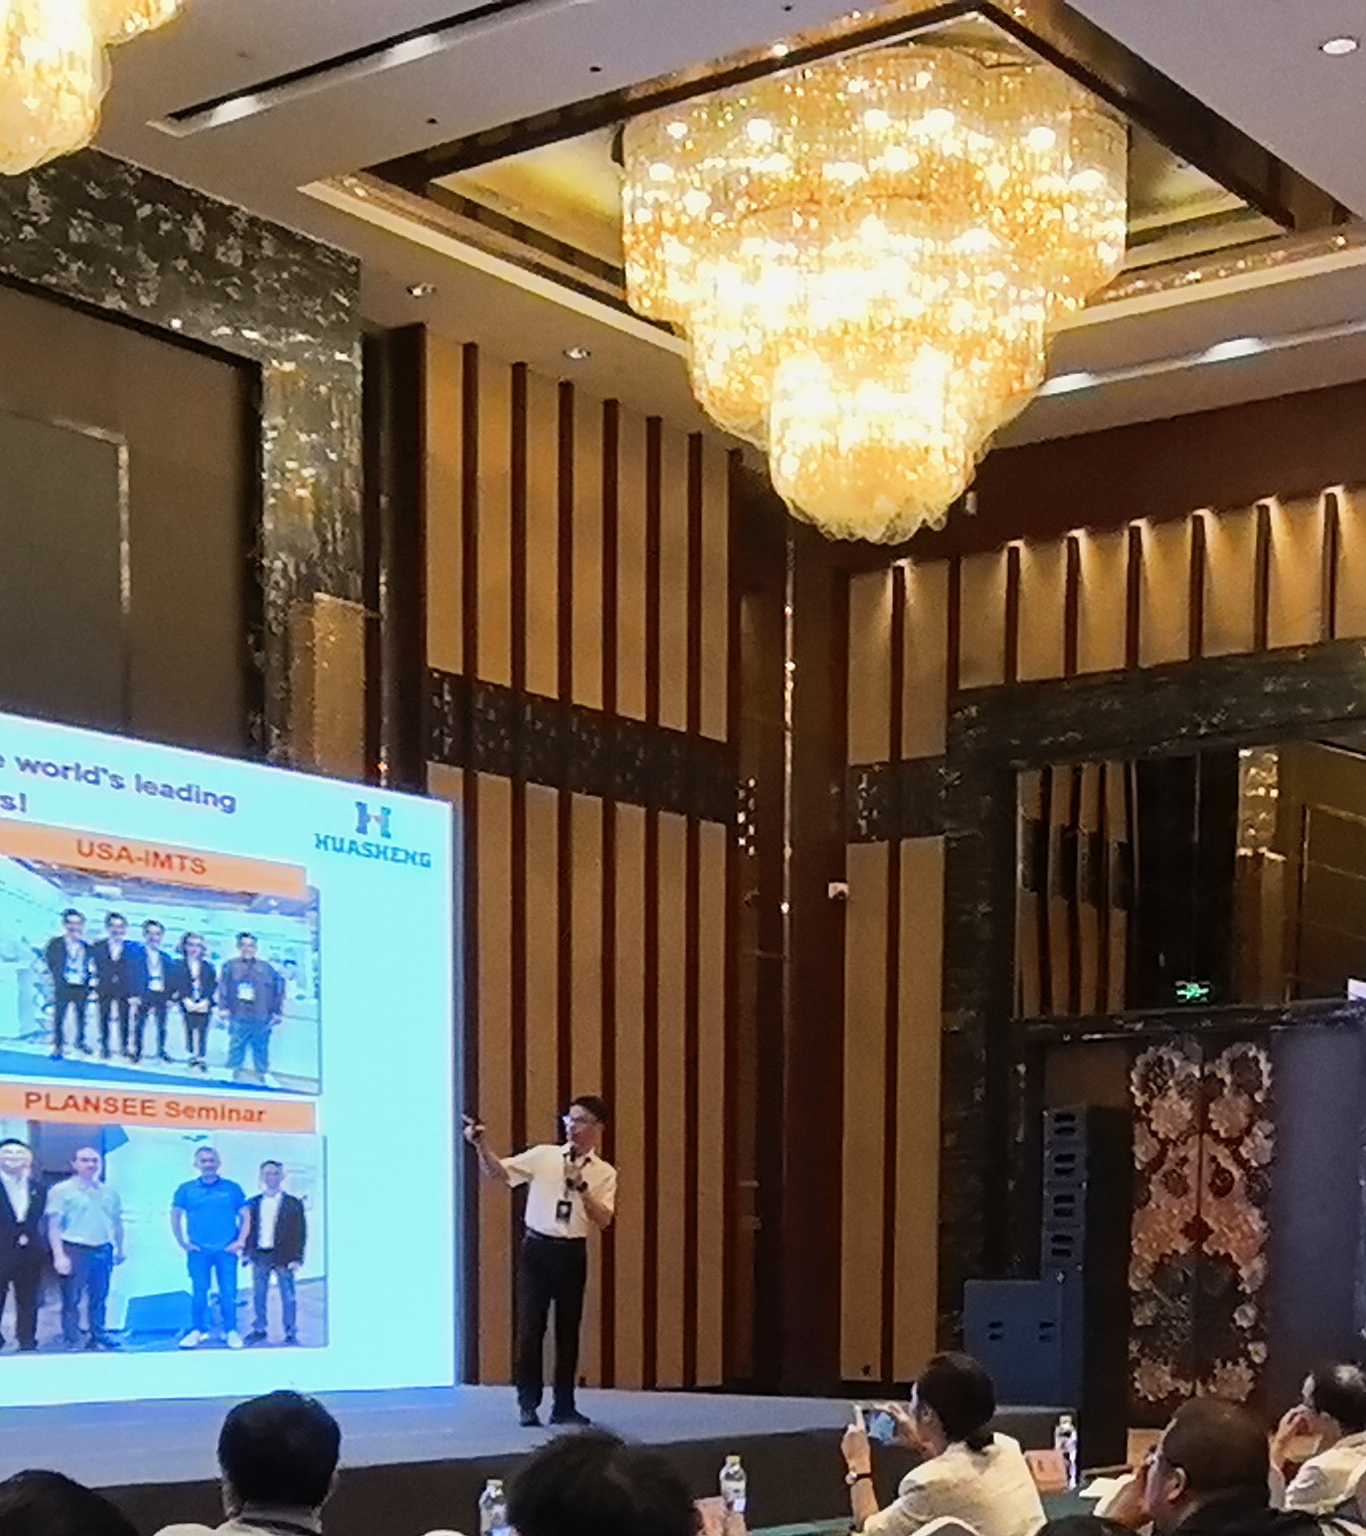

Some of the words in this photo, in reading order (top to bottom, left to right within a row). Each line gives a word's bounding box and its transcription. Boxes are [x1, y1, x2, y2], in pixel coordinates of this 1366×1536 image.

[15, 752, 125, 791] world's
[135, 773, 238, 815] leading
[77, 838, 207, 875] USA-IMTS
[314, 832, 432, 868] HUASHENG
[24, 1091, 158, 1118] PLANSEE
[164, 1100, 267, 1123] Seminar
